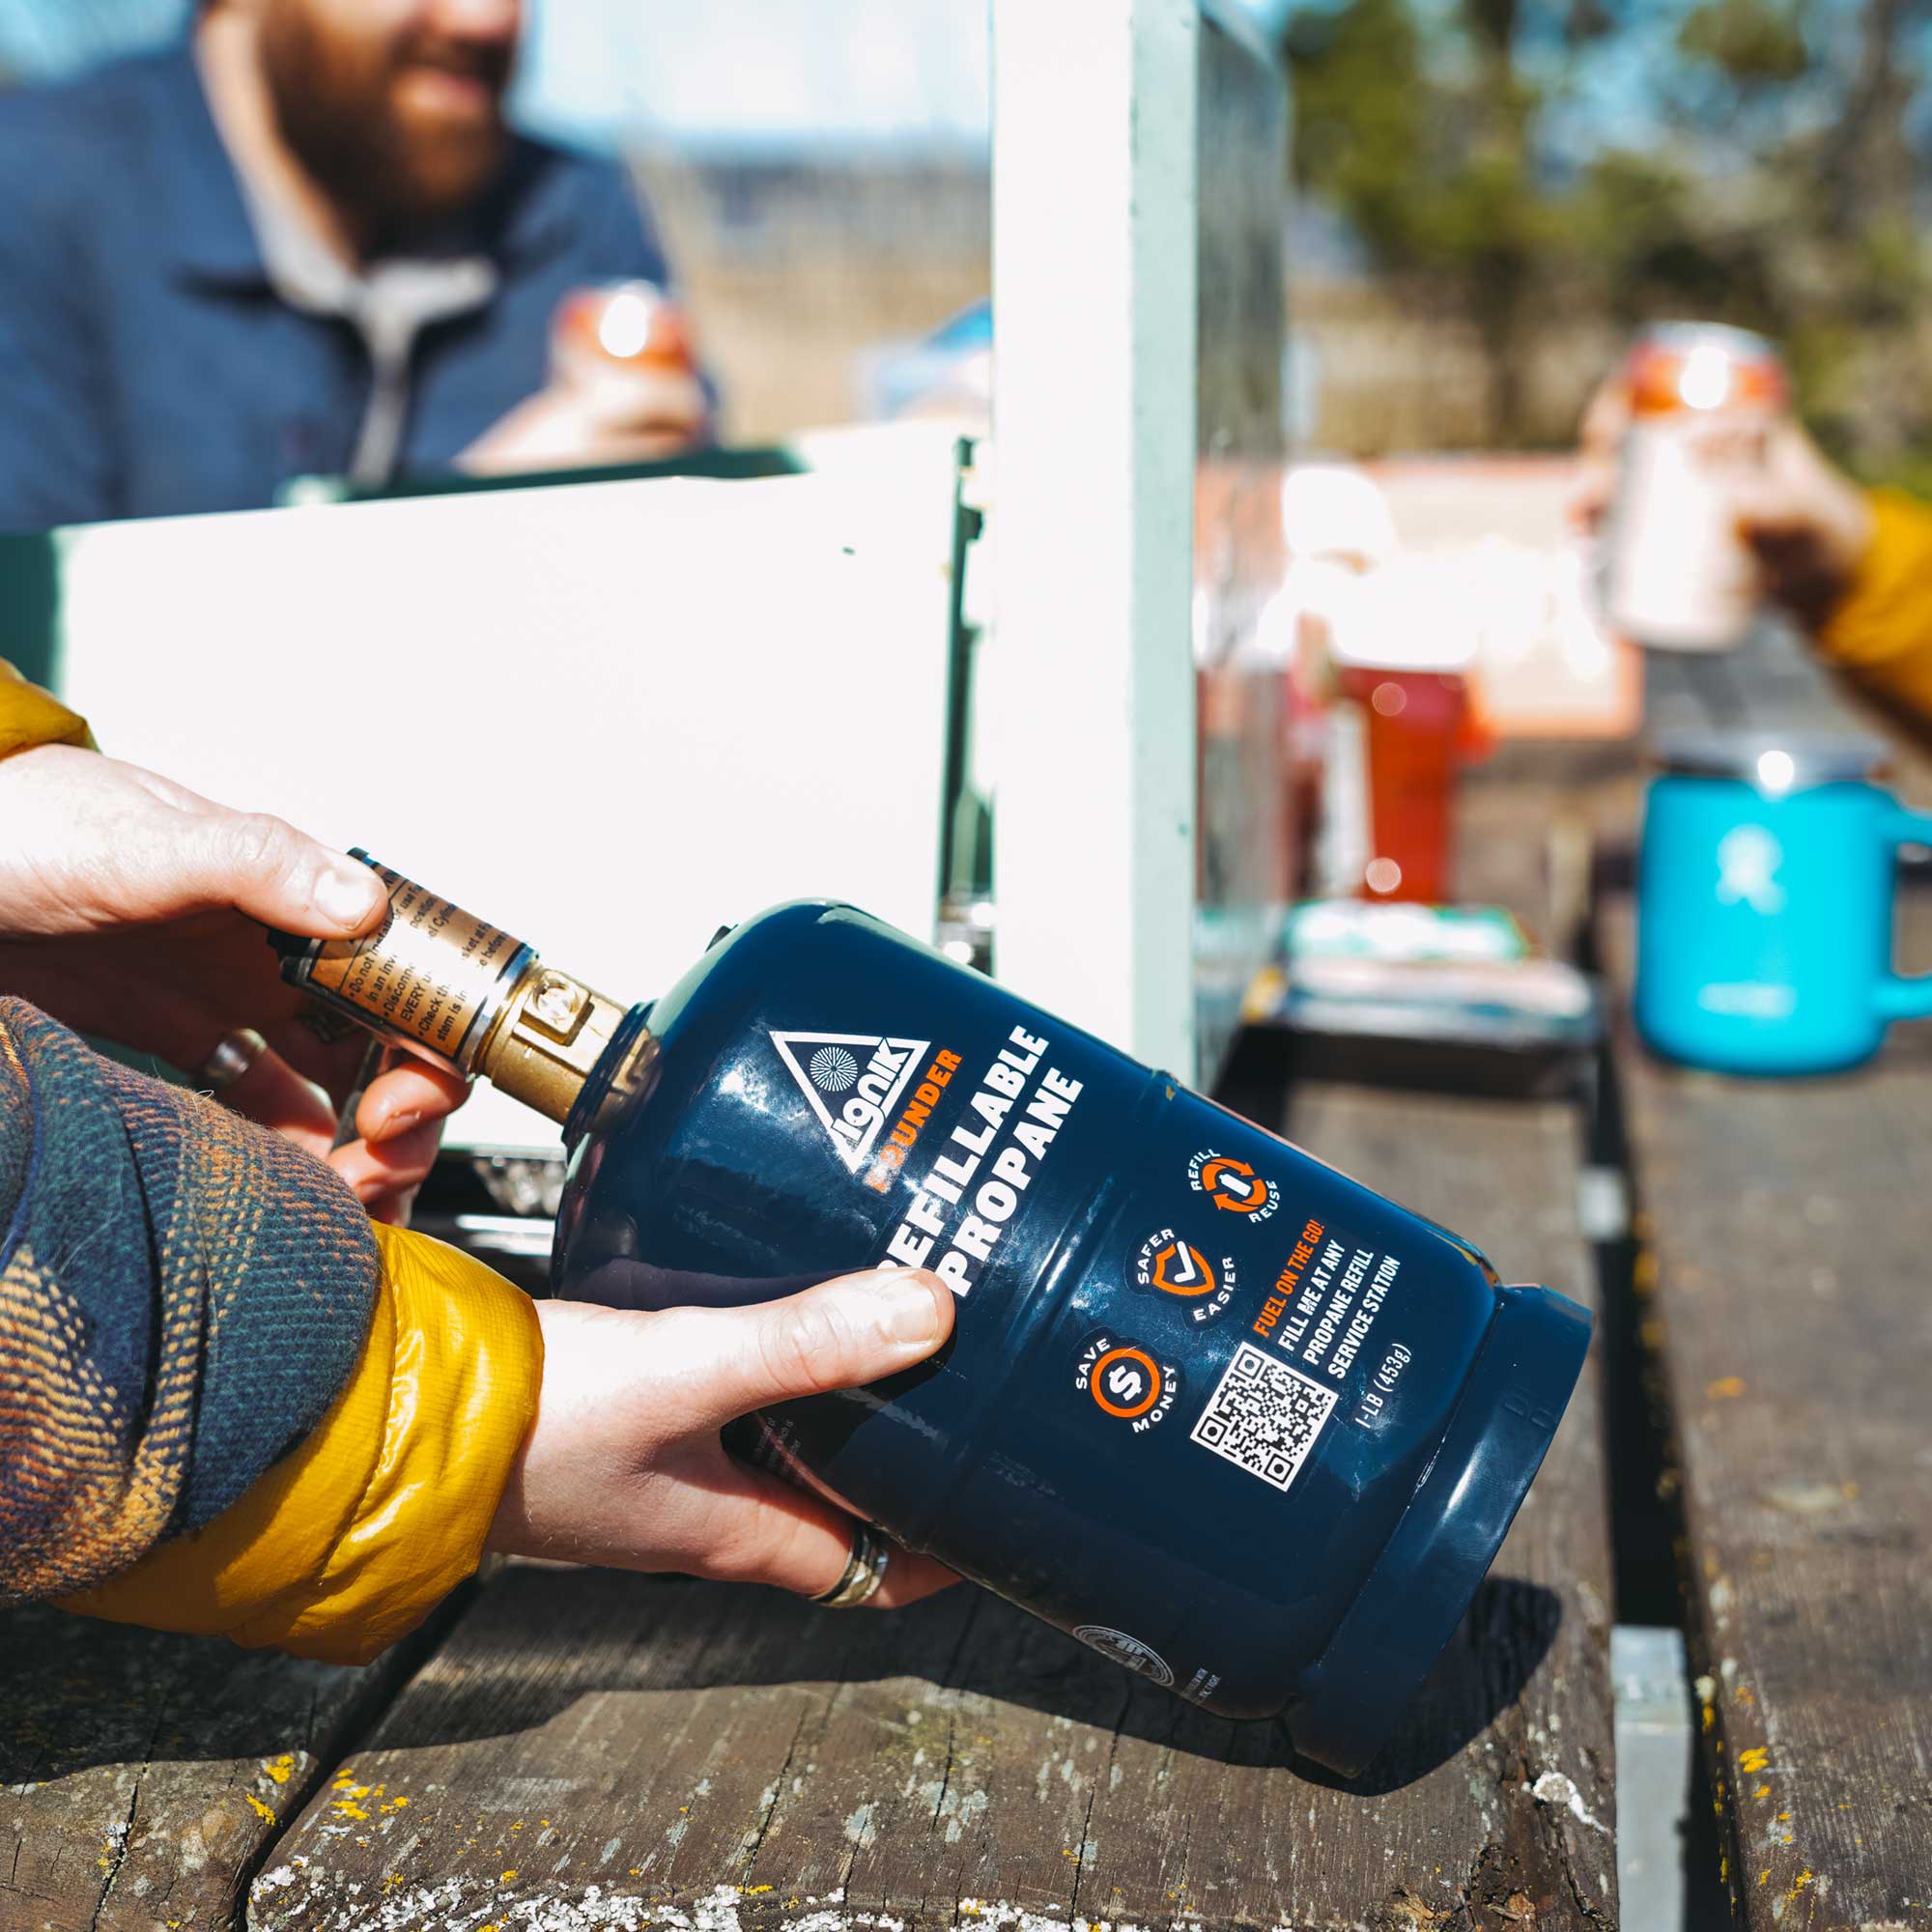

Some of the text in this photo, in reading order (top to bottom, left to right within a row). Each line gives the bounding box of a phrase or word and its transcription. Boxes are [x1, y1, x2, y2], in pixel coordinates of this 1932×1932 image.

[359, 957, 375, 975] not
[400, 981, 427, 1022] EVERY
[418, 996, 443, 1033] Check
[876, 1024, 1050, 1270] EFILLABLE
[1187, 1148, 1221, 1191] REFILL
[934, 1066, 1084, 1297] PROPANE
[1248, 1180, 1280, 1223] REUSE
[1138, 1228, 1176, 1285] SAFER
[1253, 1218, 1326, 1338] FUEL ON THE GO!
[1193, 1257, 1236, 1321] EASIER
[1277, 1239, 1346, 1352] FILL ME AT ANY
[1302, 1249, 1375, 1366] PROPANE REFILL
[1327, 1255, 1401, 1379] SERVICE STATION
[1075, 1338, 1111, 1390] SAVE
[1374, 1342, 1413, 1392] (453g)
[1132, 1365, 1177, 1434] MONEY
